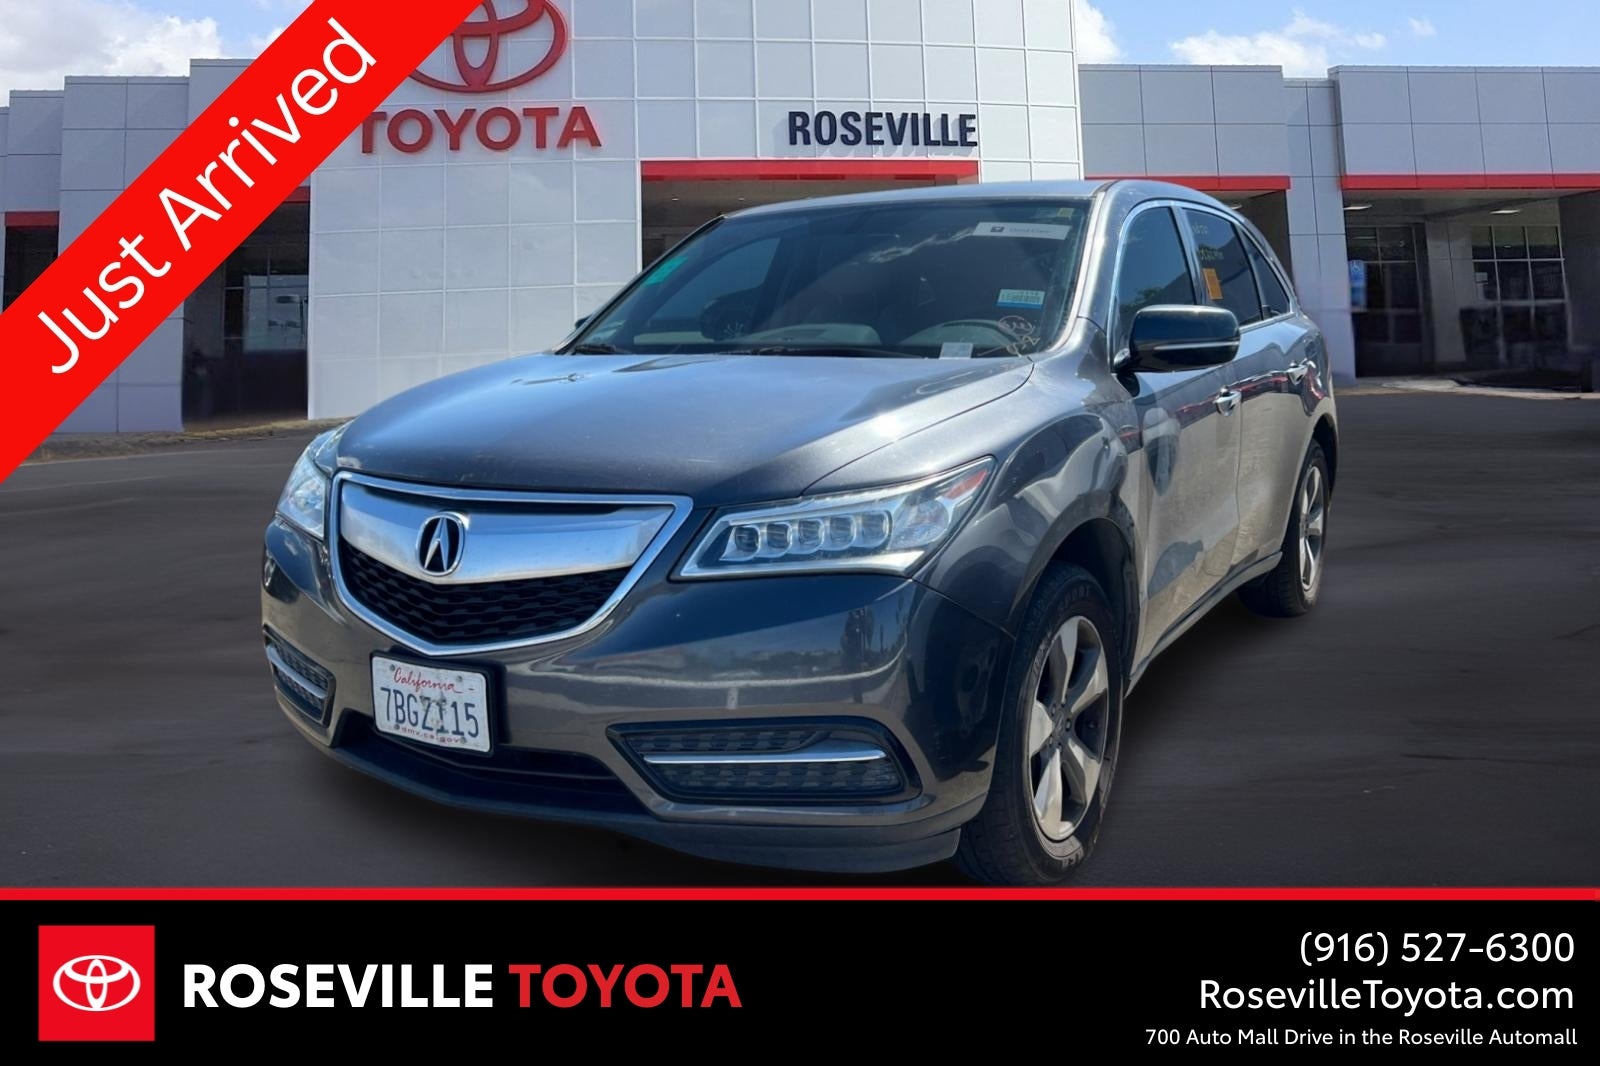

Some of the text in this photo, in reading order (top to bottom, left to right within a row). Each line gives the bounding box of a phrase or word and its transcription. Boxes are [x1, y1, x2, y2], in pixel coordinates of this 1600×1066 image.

[361, 106, 602, 154] TOYOTA
[788, 110, 978, 147] ROSEVILLE
[393, 666, 464, 694] California
[380, 687, 479, 738] 7BGZ115
